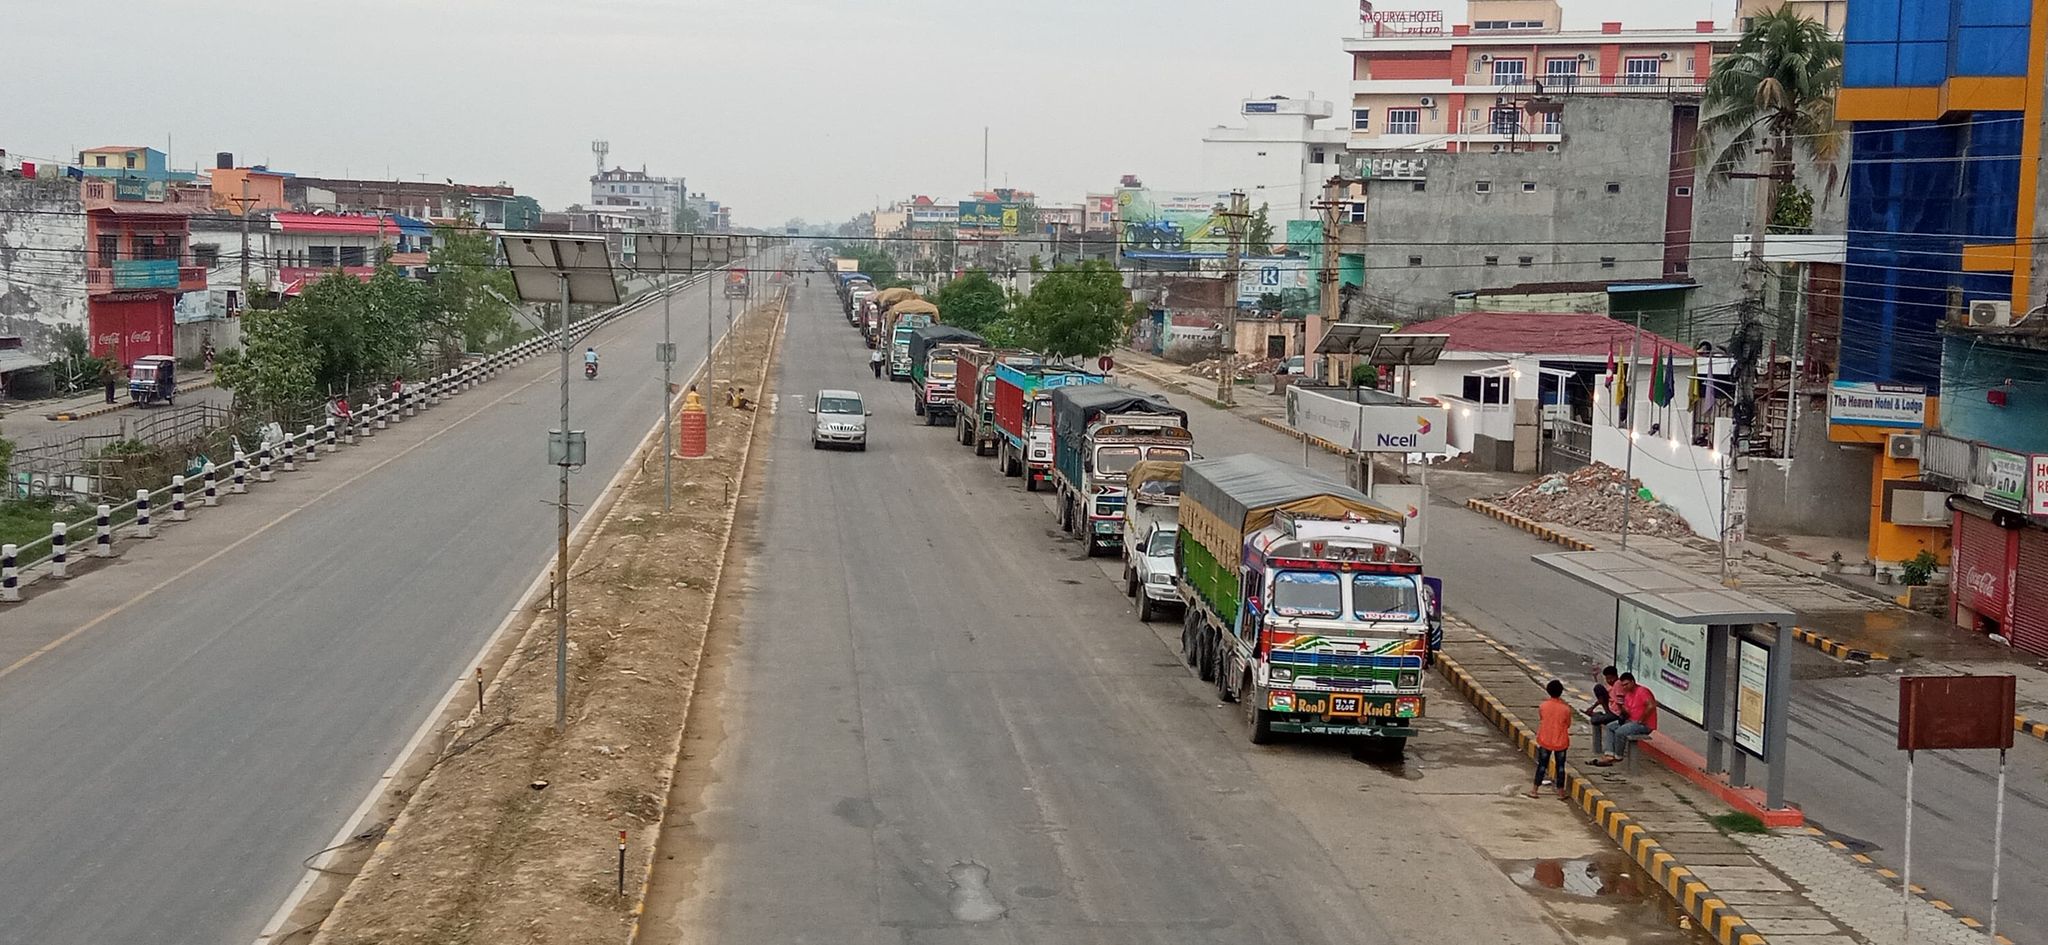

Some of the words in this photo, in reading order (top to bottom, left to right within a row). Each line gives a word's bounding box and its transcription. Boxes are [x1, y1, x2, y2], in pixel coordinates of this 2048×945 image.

[1409, 11, 1442, 22] HOTEL
[118, 184, 143, 195] TUBORG
[131, 330, 151, 343] Coca-Cola
[1834, 395, 1846, 407] The
[1848, 396, 1873, 409] Heaven
[1875, 396, 1893, 410] Hotel
[1894, 399, 1900, 410] &
[1902, 398, 1922, 414] Lodge
[1377, 433, 1417, 447] Ncell
[1966, 566, 1997, 600] Coca-Cola
[1668, 646, 1691, 672] Ultra
[1298, 699, 1326, 713] ROAD
[1363, 701, 1392, 717] KING
